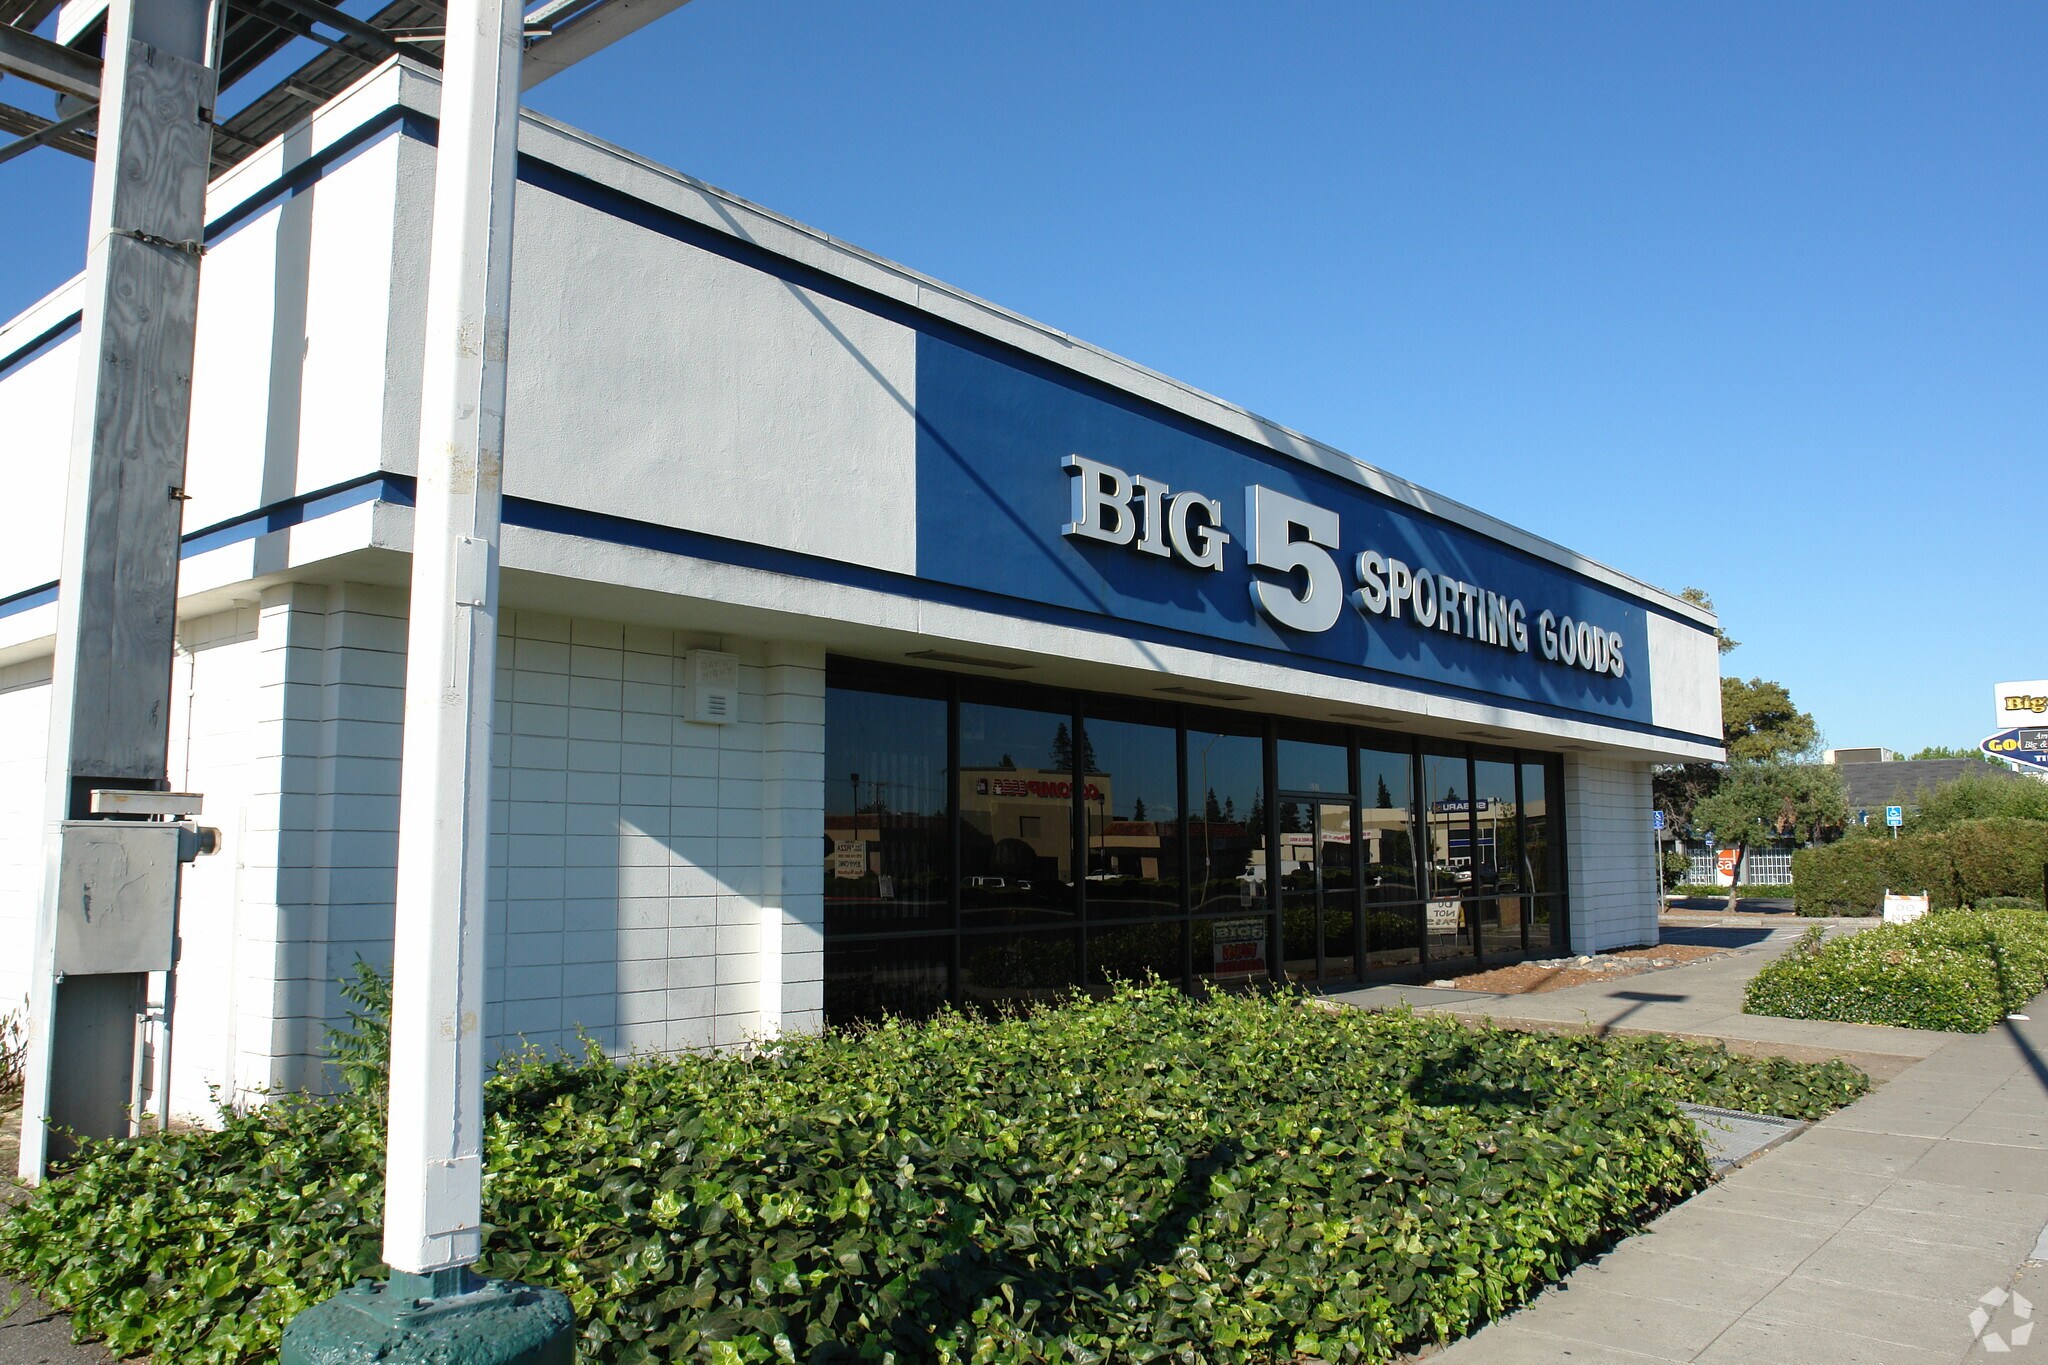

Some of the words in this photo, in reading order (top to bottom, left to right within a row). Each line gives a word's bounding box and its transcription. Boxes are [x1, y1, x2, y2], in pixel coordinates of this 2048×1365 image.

[1061, 454, 1229, 572] BIG
[1245, 484, 1343, 633] 5
[1352, 550, 1528, 653] SPORTING
[1539, 609, 1625, 678] GOODS
[2034, 732, 2048, 740] Am
[1988, 739, 2020, 751] GO
